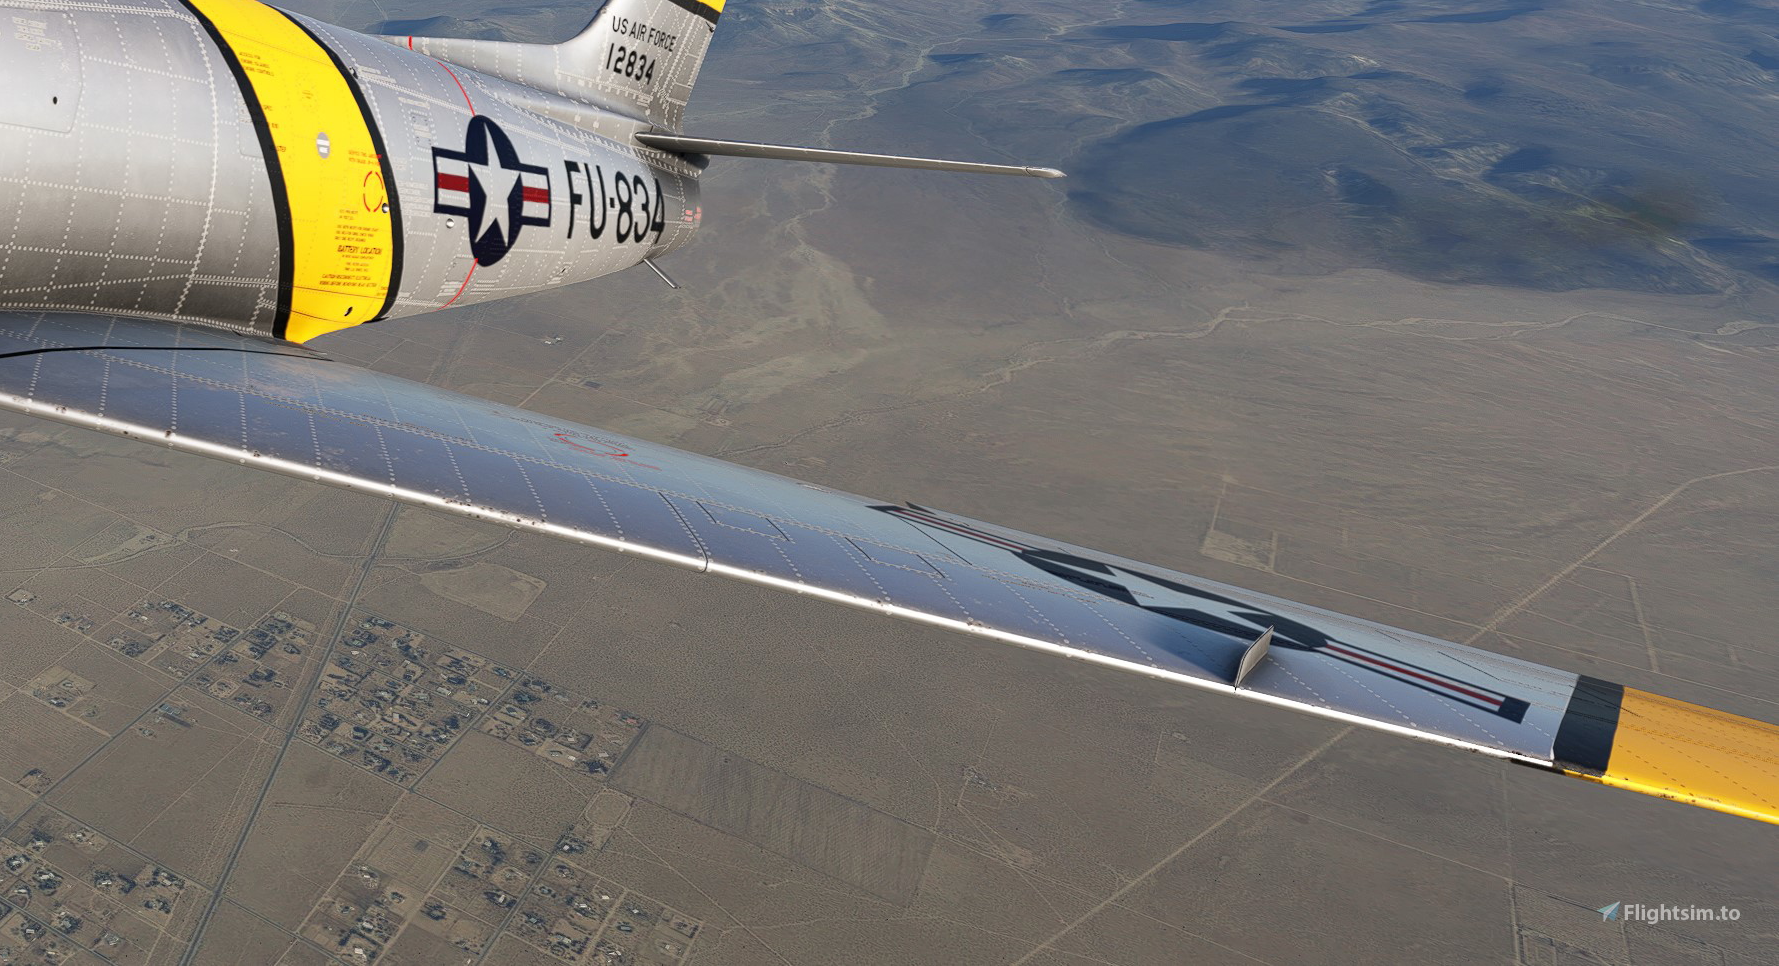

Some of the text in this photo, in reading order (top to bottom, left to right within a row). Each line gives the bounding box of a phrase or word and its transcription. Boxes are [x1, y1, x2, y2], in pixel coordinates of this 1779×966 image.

[612, 15, 677, 52] US AIR FORCE
[606, 43, 656, 85] 12834
[564, 160, 665, 244] FU-834
